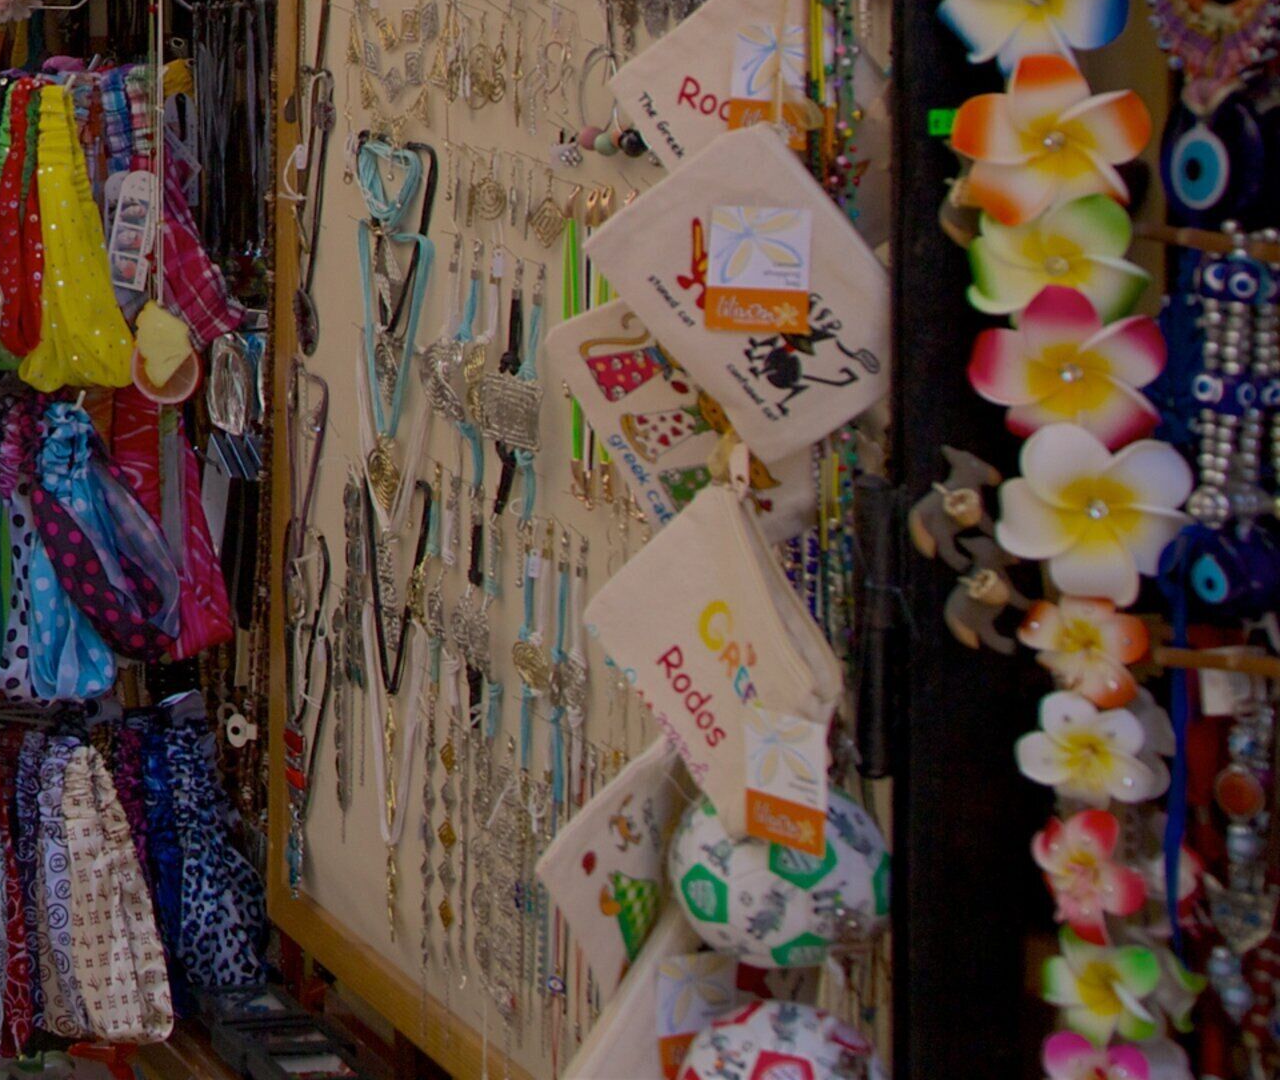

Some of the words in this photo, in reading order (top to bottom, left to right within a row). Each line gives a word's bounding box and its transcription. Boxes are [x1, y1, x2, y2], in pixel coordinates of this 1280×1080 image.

[638, 91, 657, 118] The
[657, 120, 685, 159] Greek
[608, 433, 650, 487] greek
[656, 645, 727, 749] Rodos
